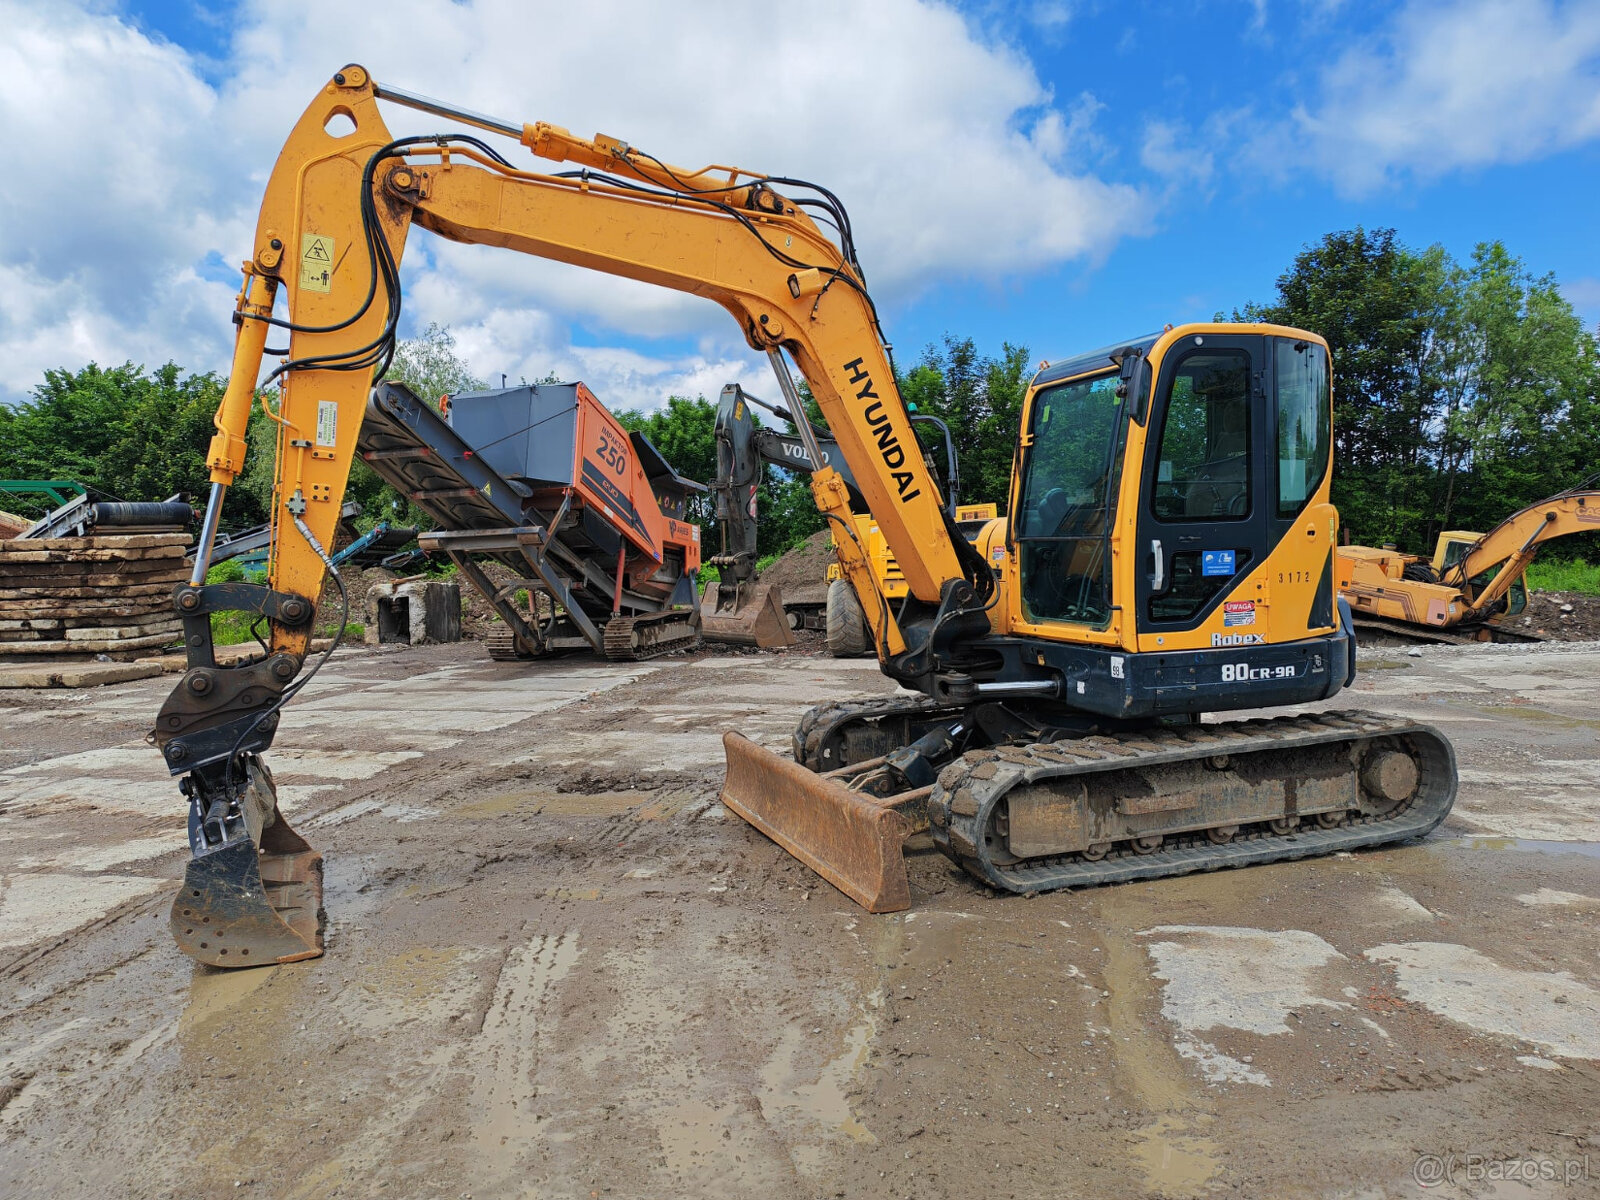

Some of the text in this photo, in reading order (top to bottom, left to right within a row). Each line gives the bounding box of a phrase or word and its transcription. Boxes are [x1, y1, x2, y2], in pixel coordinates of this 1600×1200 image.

[843, 357, 920, 503] HYUNDAI
[596, 436, 625, 475] 250
[781, 442, 829, 464] VOLO
[1278, 571, 1310, 584] 3172
[1226, 602, 1252, 612] UWAGA
[1211, 632, 1266, 647] Robex
